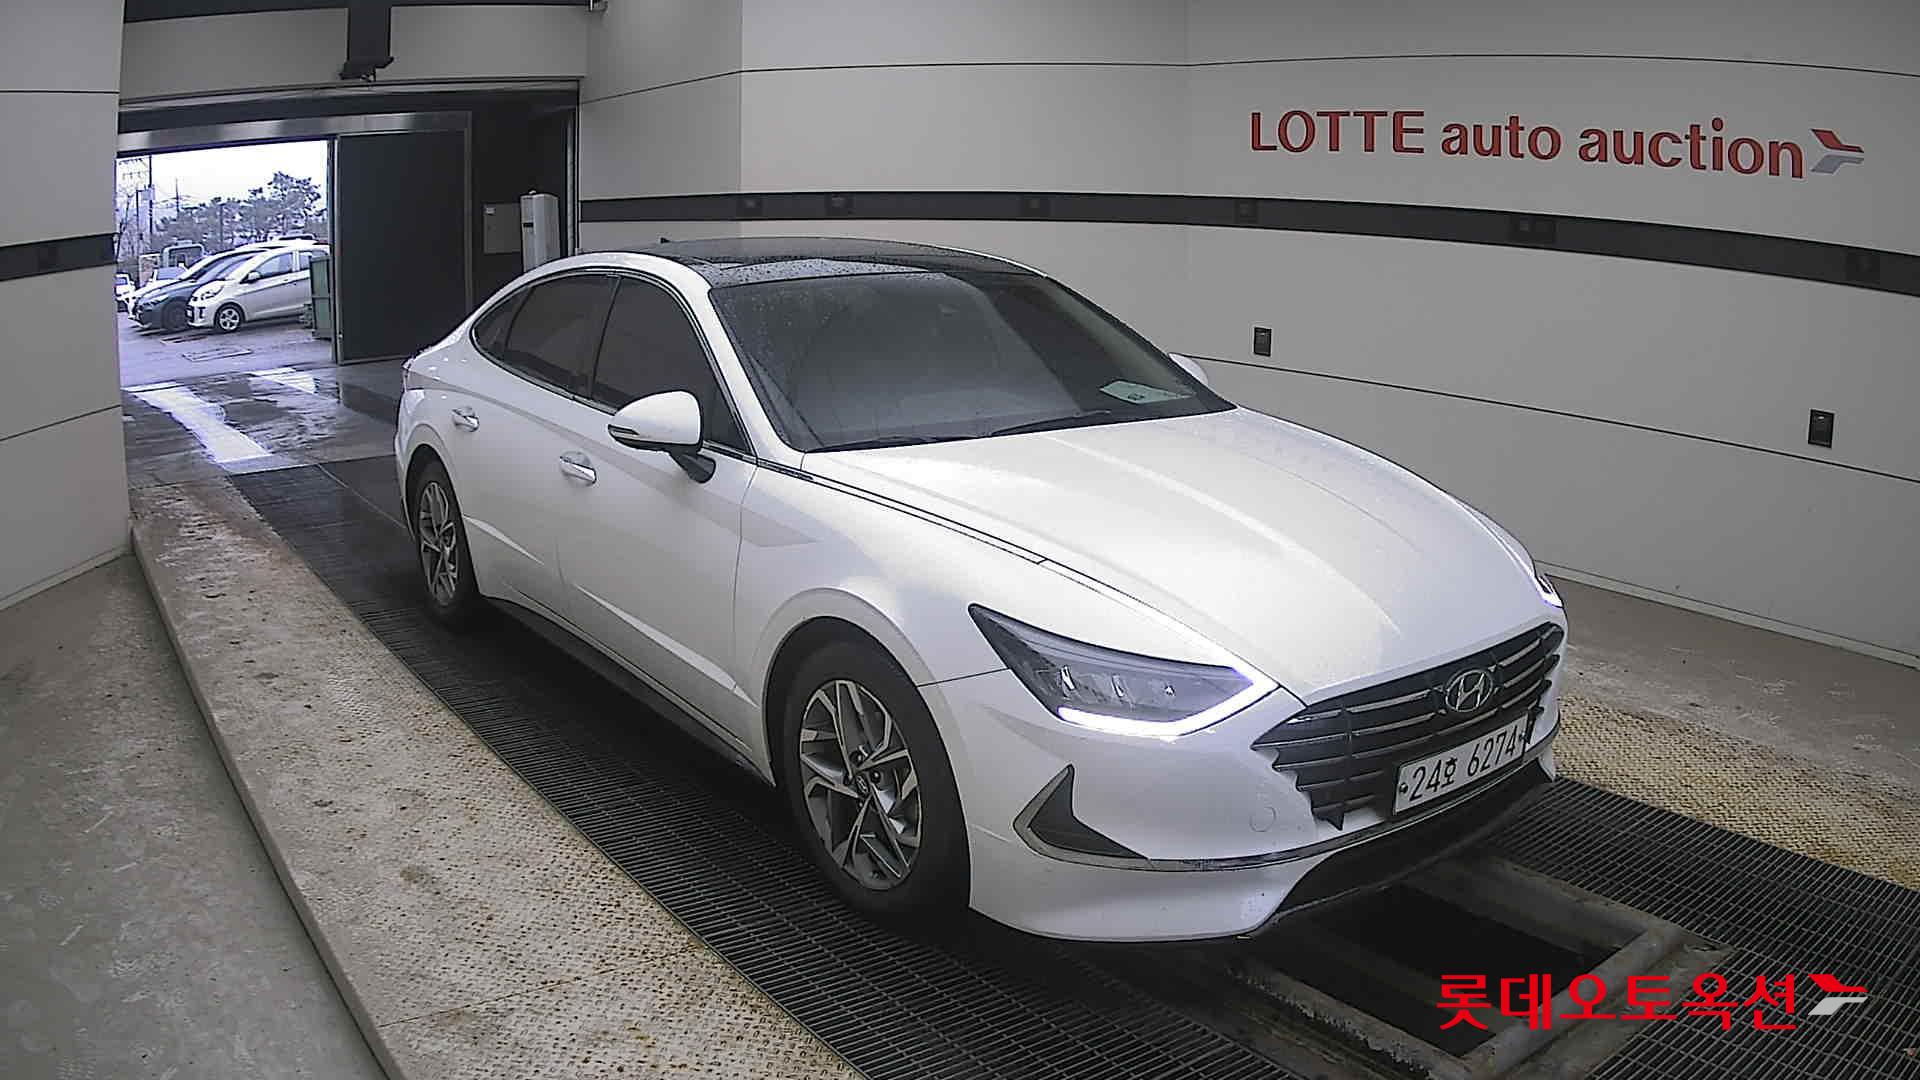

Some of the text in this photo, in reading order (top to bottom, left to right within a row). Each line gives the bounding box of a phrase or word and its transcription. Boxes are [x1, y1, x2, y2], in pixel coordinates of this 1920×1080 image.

[1249, 110, 1804, 179] LOTTE auto auction
[1409, 724, 1518, 802] 24호 6274
